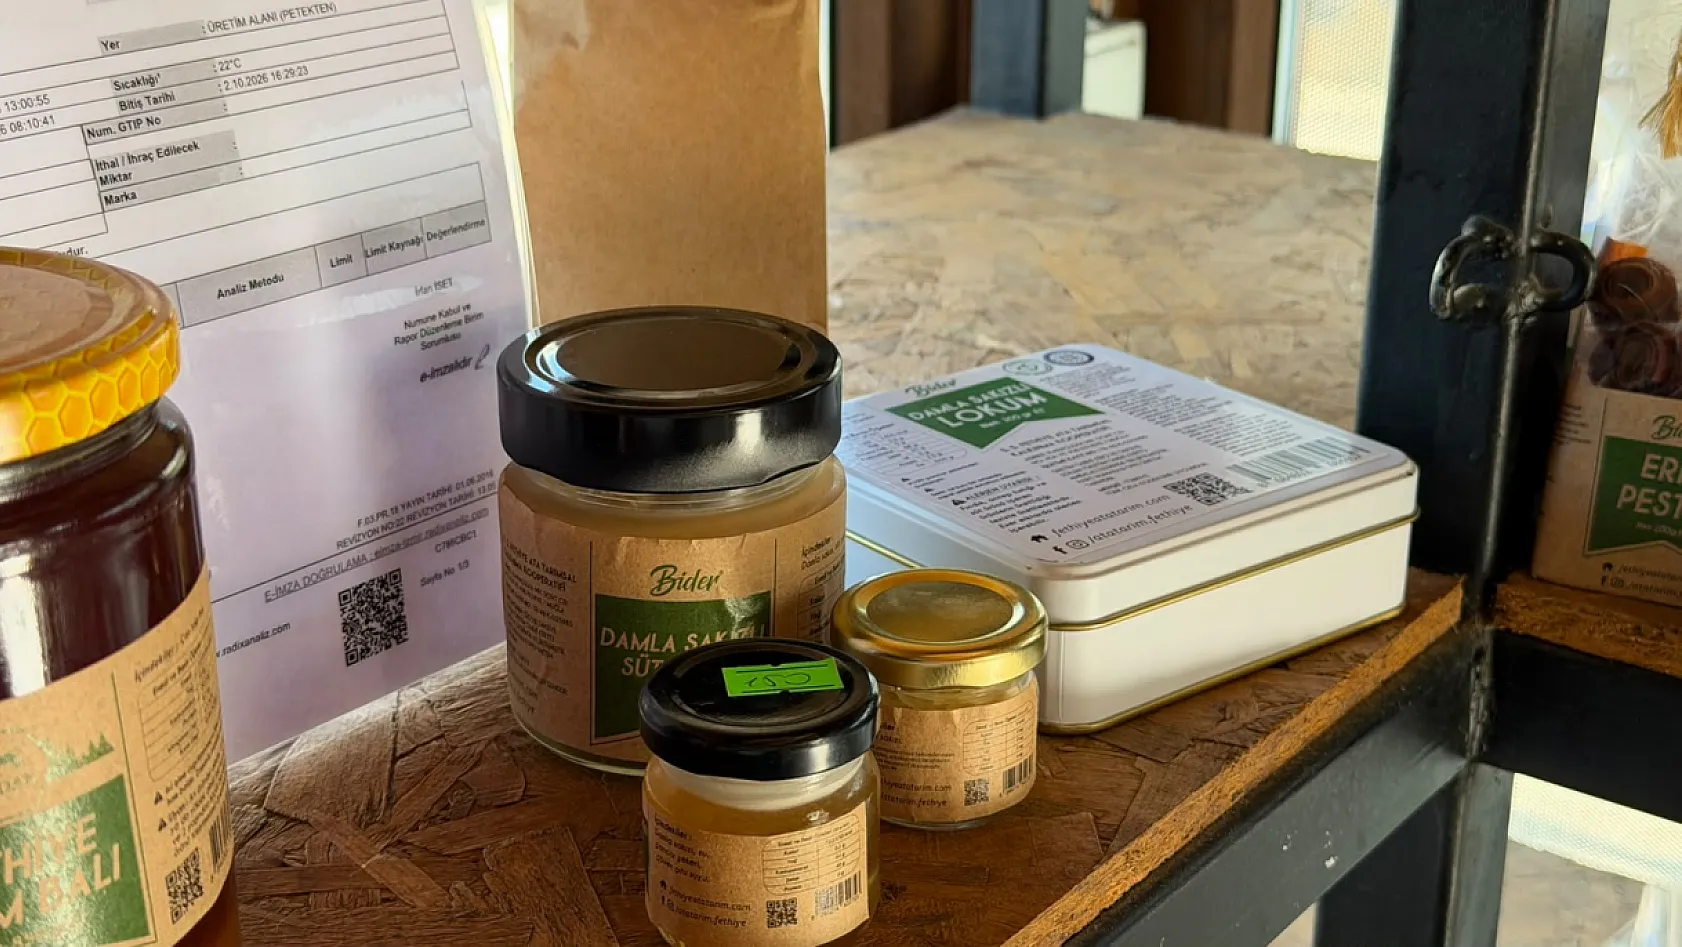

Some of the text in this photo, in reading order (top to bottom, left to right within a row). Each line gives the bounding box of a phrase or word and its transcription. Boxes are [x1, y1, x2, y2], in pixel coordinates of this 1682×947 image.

[207, 2, 337, 33] ÜRETİM ALANI (PETEKTEN)
[100, 38, 121, 51] Yer
[218, 57, 243, 71] 22°C
[223, 65, 309, 90] 2.10.2026 16:29:23
[5, 93, 51, 112] 13:00:55
[118, 91, 175, 111] Bitiş Tarihi
[10, 115, 55, 133] 08:10:41
[87, 127, 117, 139] Num.
[146, 116, 161, 126] No
[156, 141, 201, 158] Edilecek
[99, 173, 134, 187] Miktar
[103, 191, 138, 207] Marka
[426, 218, 487, 241] Değerlendirme
[329, 253, 354, 269] Limit
[365, 243, 388, 258] Limit
[216, 272, 285, 299] Analiz Metodu
[461, 303, 471, 312] ve
[394, 333, 418, 345] Rapor
[908, 382, 1032, 421] DAMLA SAKIZLI
[938, 391, 1049, 428] LOKUM
[400, 496, 425, 511] YAYIN
[1051, 493, 1172, 538] fethiyeatatarim.com
[1089, 504, 1194, 545] /atatarim.fethiye
[336, 528, 380, 551] REVİZYON
[650, 564, 725, 597] Bider
[600, 627, 677, 653] DAMLA
[40, 842, 121, 914] BALI
